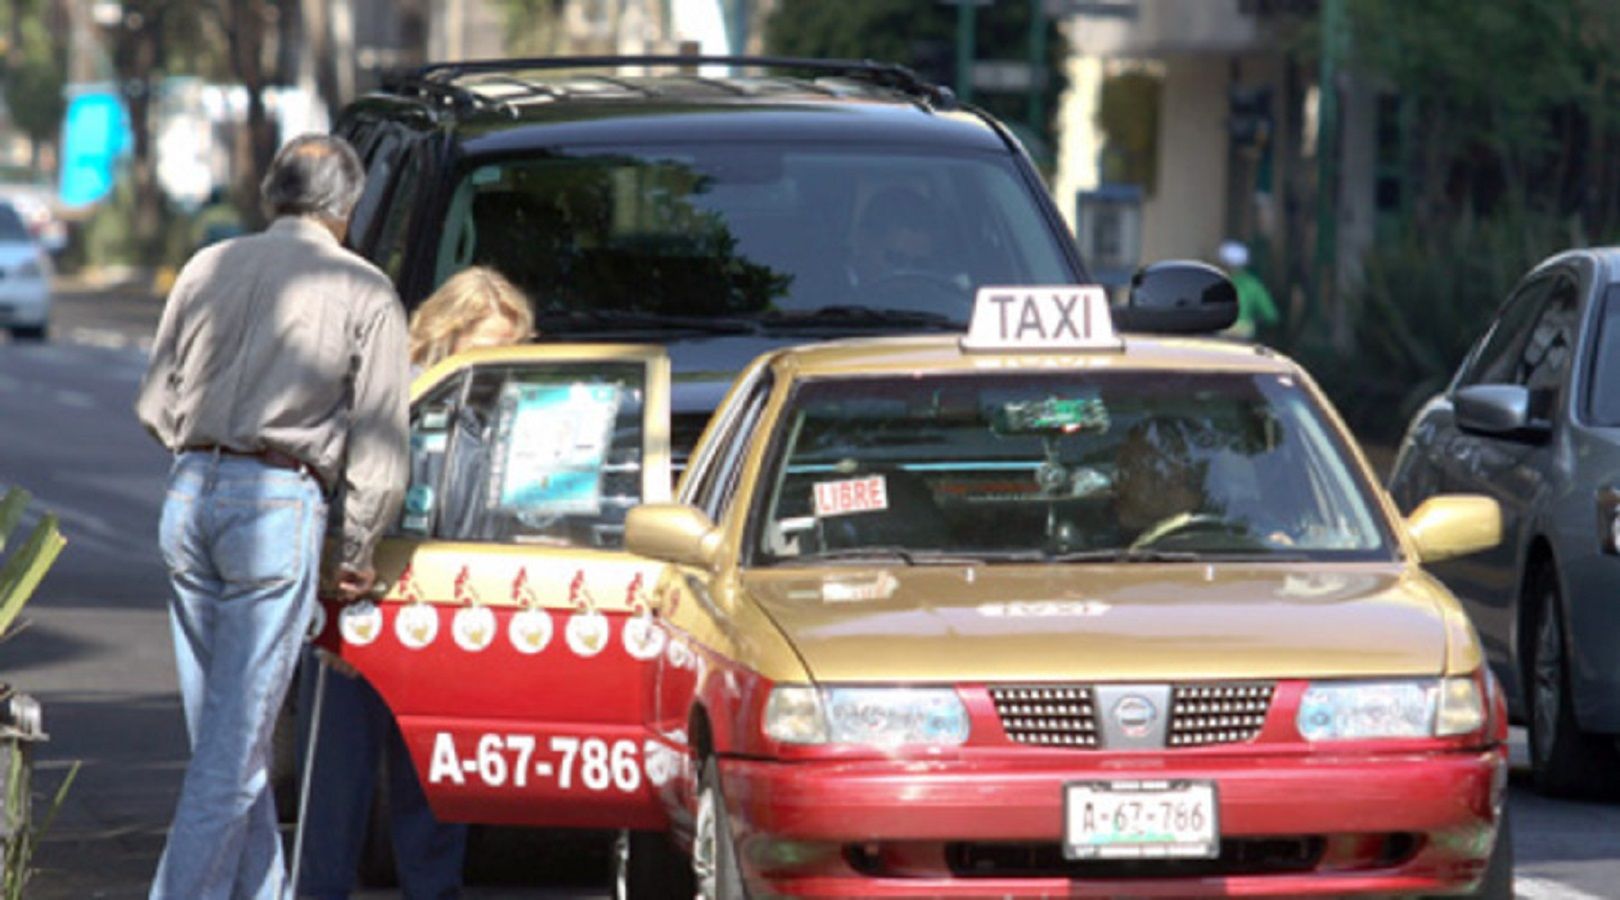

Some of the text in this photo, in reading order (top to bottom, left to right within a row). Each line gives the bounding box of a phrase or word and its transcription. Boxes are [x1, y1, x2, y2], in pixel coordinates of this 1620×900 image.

[989, 294, 1092, 340] TAXI
[817, 479, 883, 512] LIBRE
[428, 731, 642, 793] A-67-786
[1083, 801, 1206, 833] A-67-786
